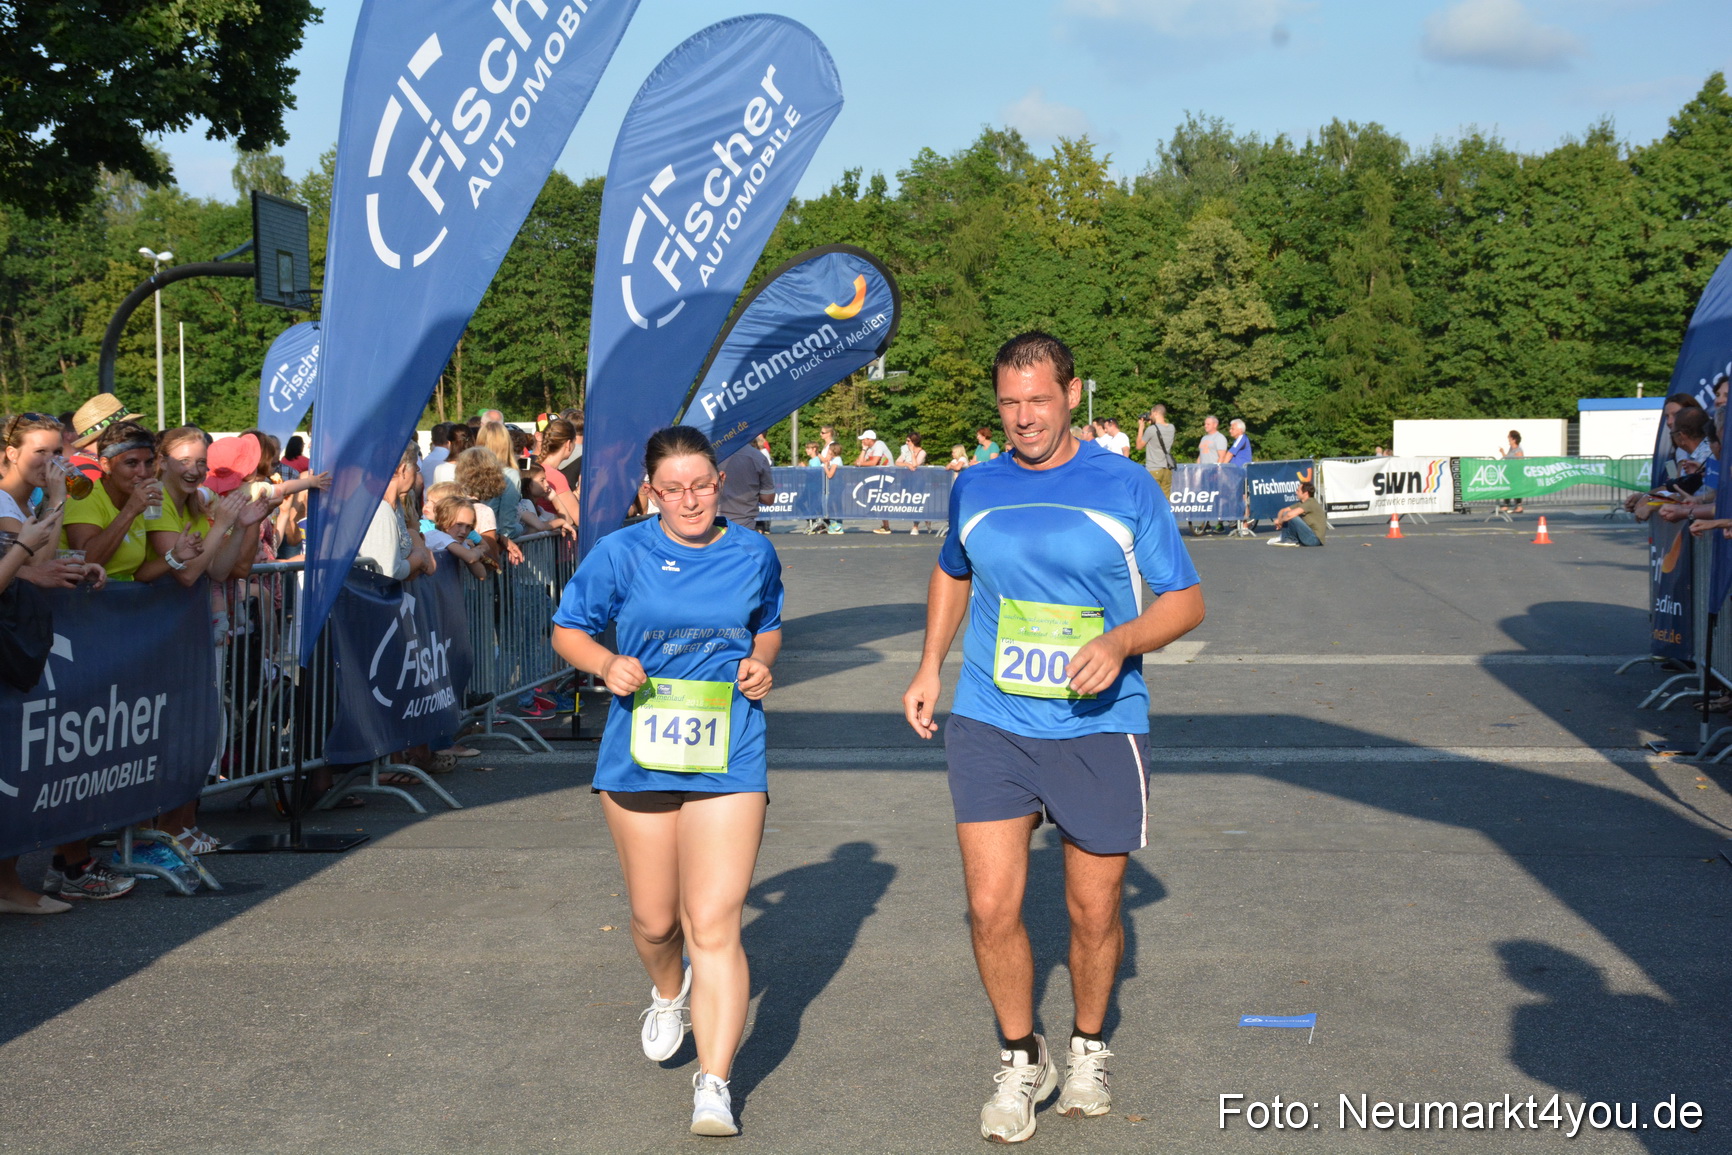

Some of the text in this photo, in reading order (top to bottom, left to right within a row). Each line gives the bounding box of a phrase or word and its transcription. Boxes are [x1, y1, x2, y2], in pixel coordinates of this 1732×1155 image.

[468, 0, 592, 210] AUTOMOBI
[652, 64, 784, 292] Fischer
[699, 105, 801, 288] AUTOMOBILE
[789, 312, 887, 381] Druck und Medien
[280, 339, 320, 401] Fische
[701, 323, 839, 421] Frischmann
[1373, 471, 1422, 495] swn
[1469, 464, 1511, 486] AOK
[1523, 462, 1606, 477] GESUNDEIT
[866, 488, 930, 504] Fischer
[870, 505, 924, 513] AUTOMOBILE
[643, 630, 665, 641] WER
[668, 628, 715, 640] LAUFEND
[662, 643, 703, 655] BEWEGT
[1001, 646, 1071, 684] 200
[21, 683, 167, 772] Fischer
[644, 714, 717, 746] 1431
[32, 755, 158, 813] AUTOMOBILE
